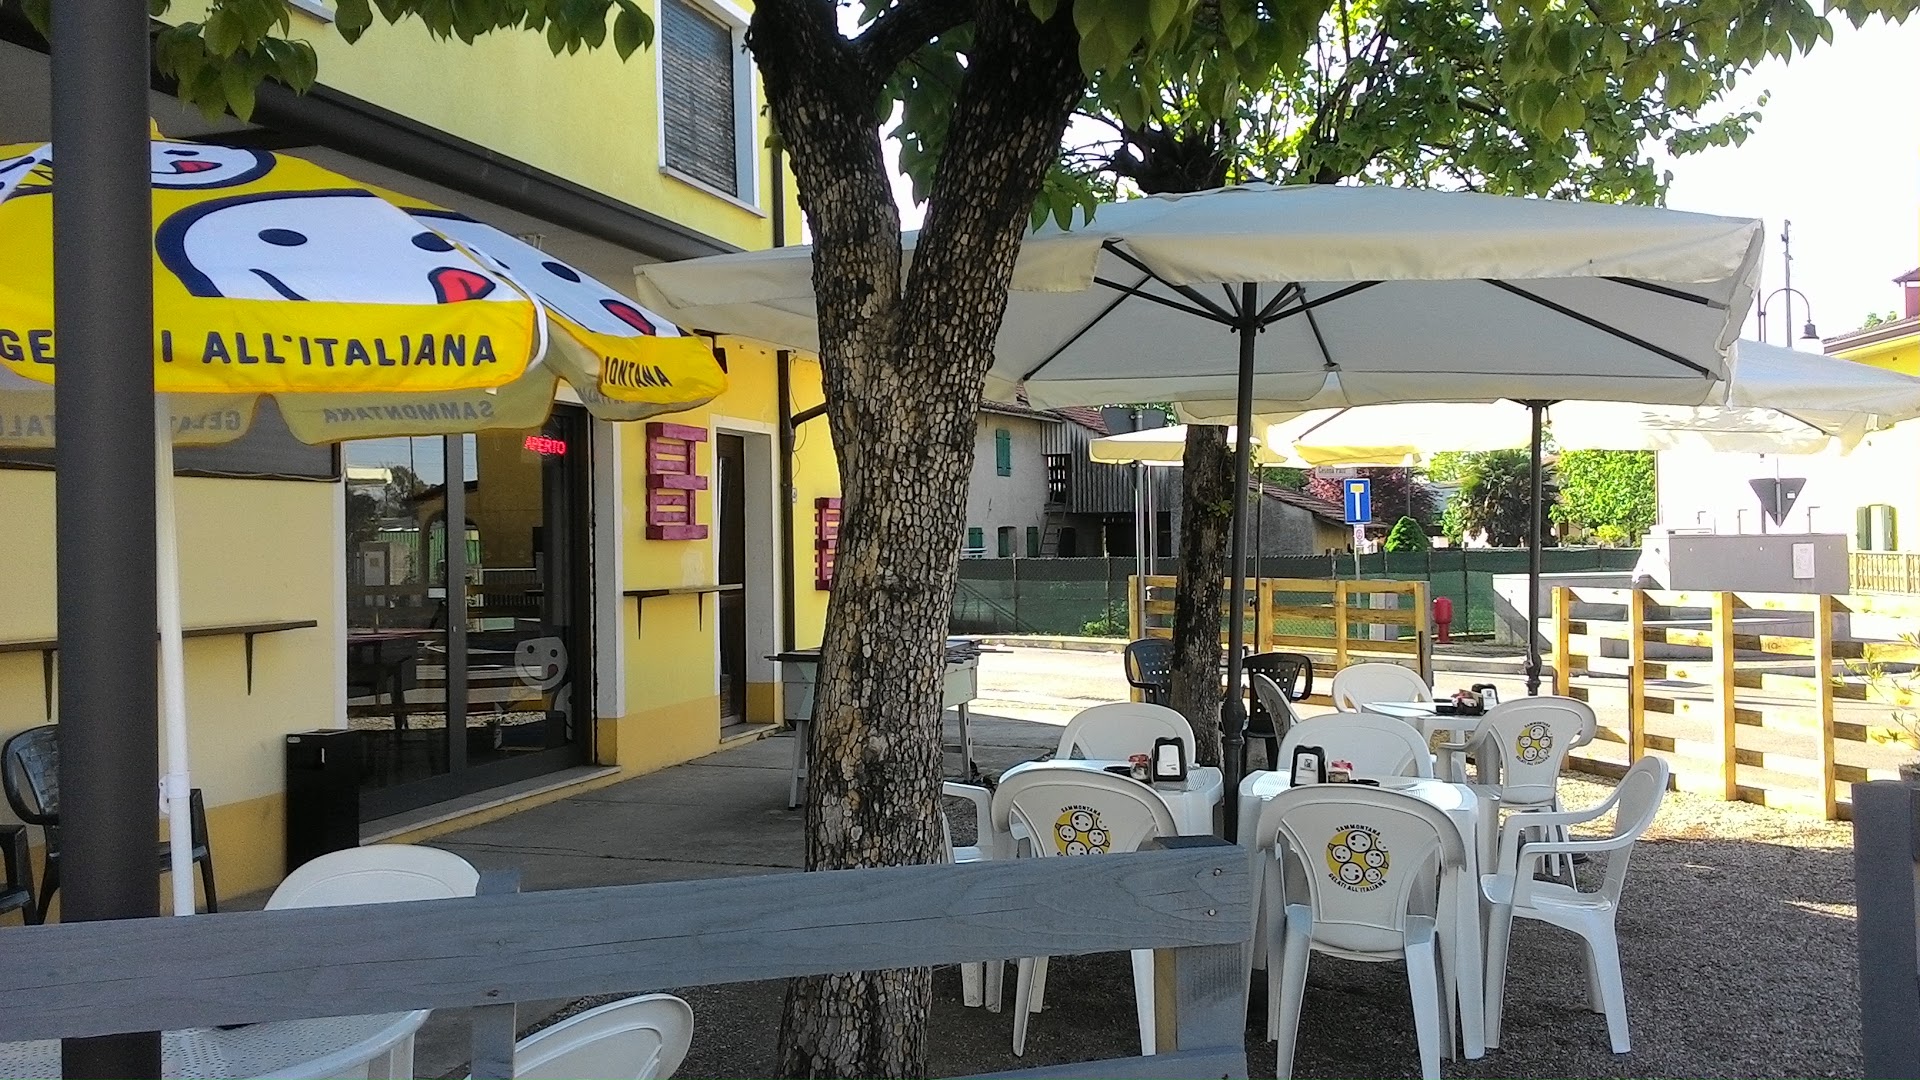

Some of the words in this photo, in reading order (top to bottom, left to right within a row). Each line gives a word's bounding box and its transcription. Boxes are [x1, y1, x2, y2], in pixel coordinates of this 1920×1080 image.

[524, 436, 567, 456] APERTO
[1061, 805, 1101, 817] SAMMONTANA
[1336, 824, 1380, 836] SAMMONTANA
